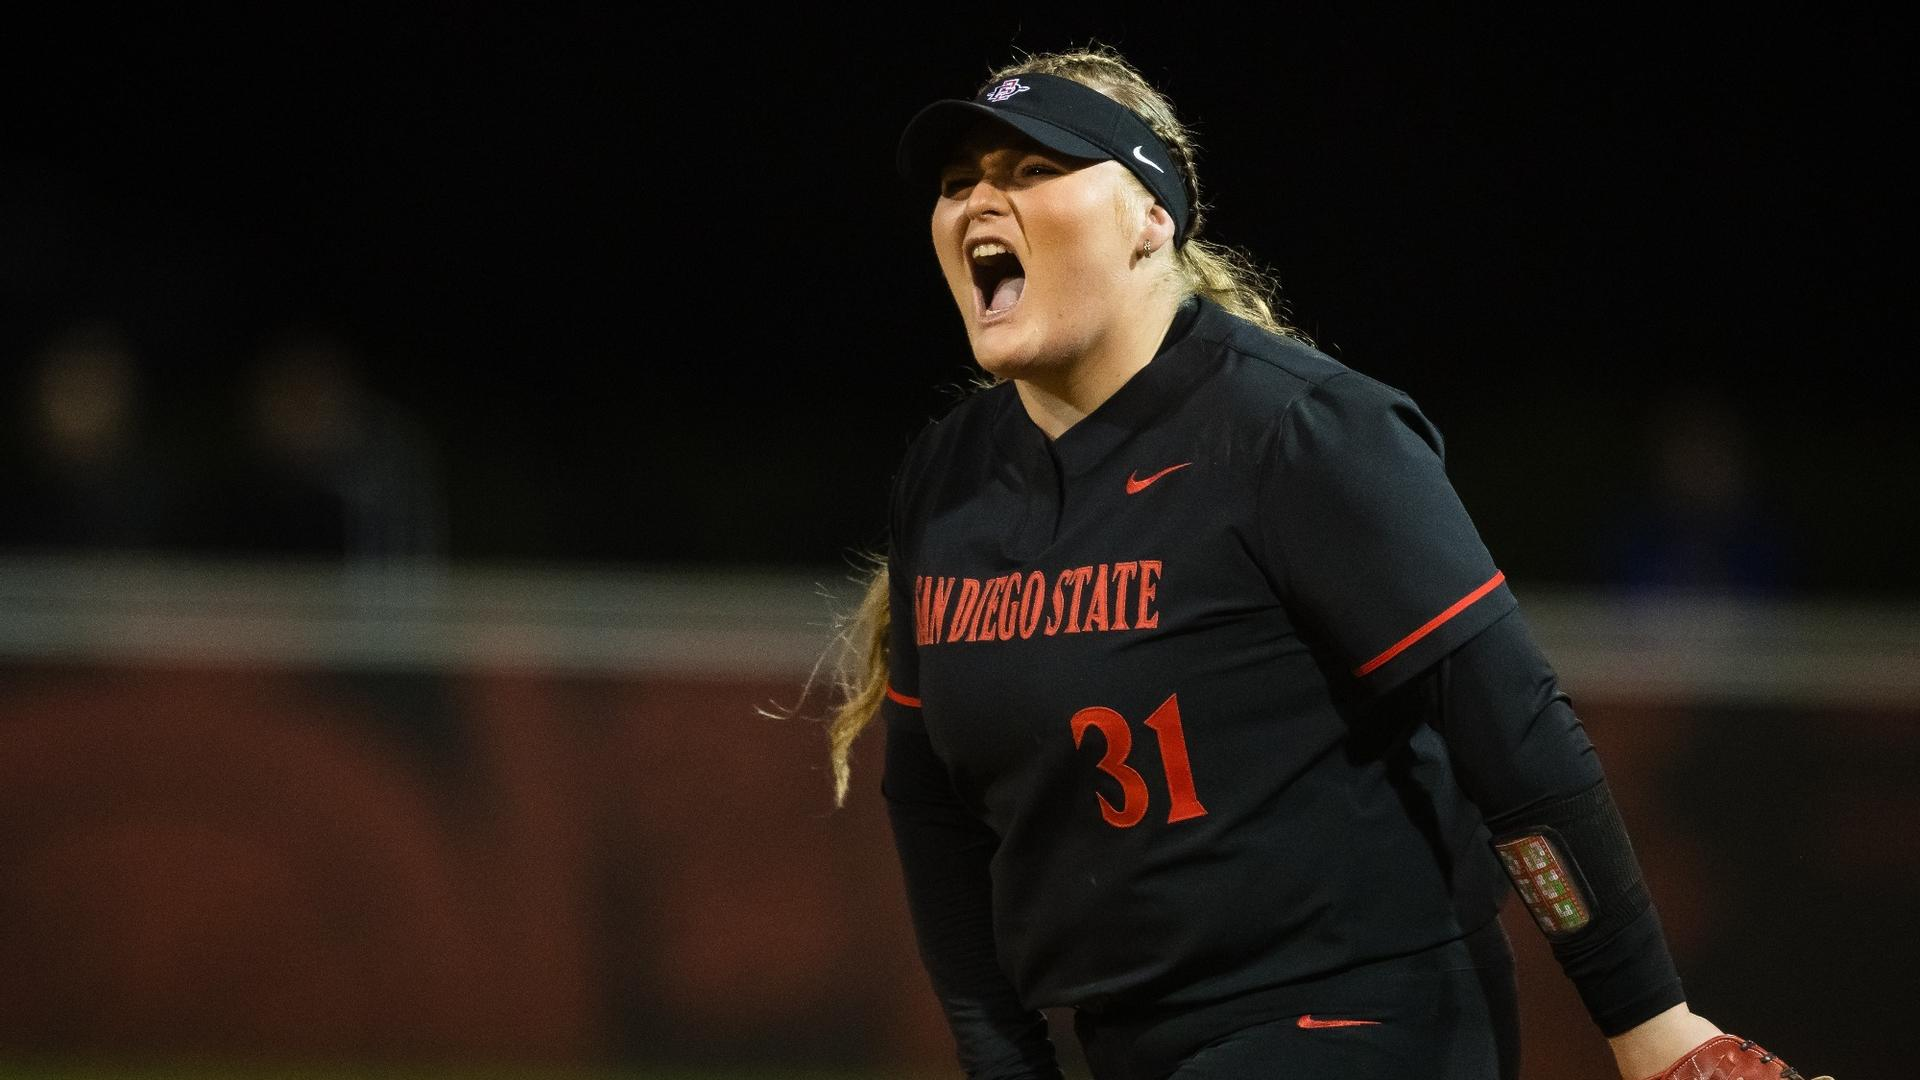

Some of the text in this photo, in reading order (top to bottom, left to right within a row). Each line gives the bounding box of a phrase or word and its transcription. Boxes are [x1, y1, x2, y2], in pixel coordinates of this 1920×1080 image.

[947, 571, 1045, 643] DIEGO
[1043, 560, 1162, 636] STATE
[1070, 693, 1208, 827] 31
